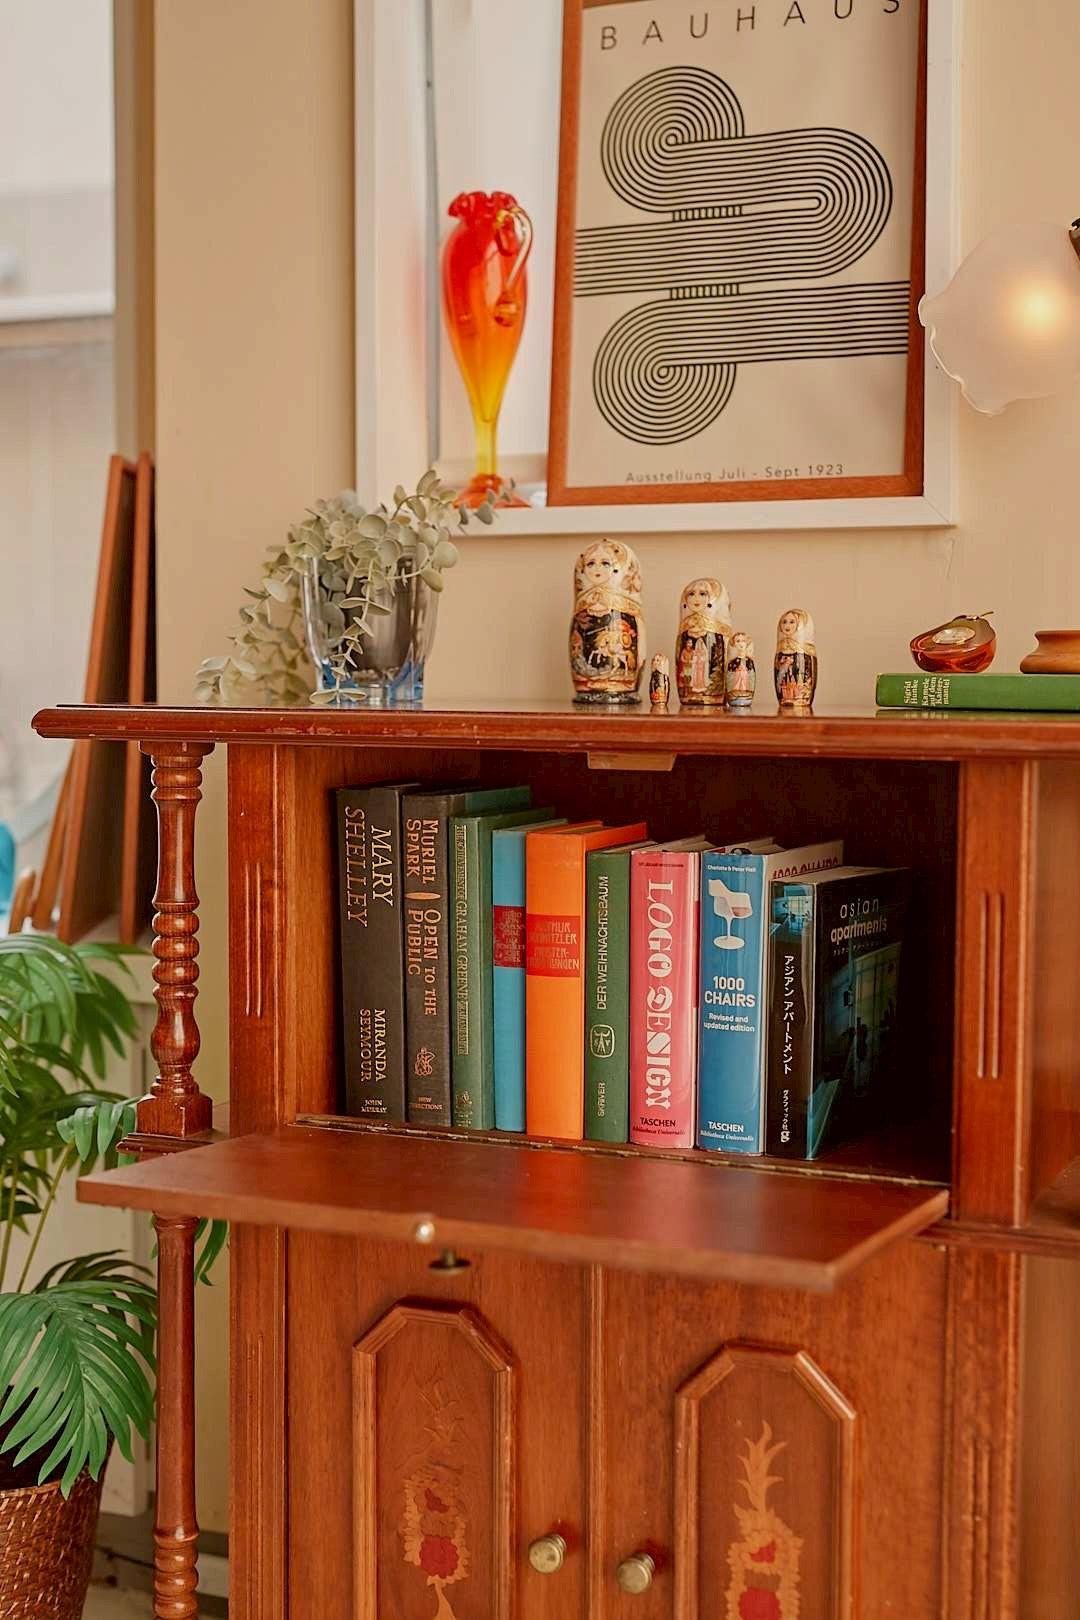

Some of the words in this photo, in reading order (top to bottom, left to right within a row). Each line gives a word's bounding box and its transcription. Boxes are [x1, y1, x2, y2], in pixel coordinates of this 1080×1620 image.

[601, 0, 900, 50] BAUHAUS
[625, 469, 712, 483] Ausstellung
[719, 467, 746, 480] Juli
[765, 466, 800, 480] Sept
[808, 464, 844, 476] 1923
[904, 681, 912, 704] Sigrid
[911, 679, 919, 704] Hunke
[922, 678, 930, 706] Kamele
[929, 677, 937, 693] dem
[406, 818, 421, 877] SPARK
[422, 819, 438, 884] MURIEL
[345, 806, 368, 928] SHELLEY
[371, 825, 394, 907] MARY
[840, 898, 879, 919] asian
[407, 909, 423, 976] PUBLIC
[423, 909, 442, 961] OPEN
[456, 901, 468, 952] GRAHAM
[597, 876, 608, 983] WEIHNACHTSBAUM
[647, 879, 674, 978] LOGO
[831, 917, 887, 945] apartments
[424, 967, 436, 983] TO
[457, 955, 468, 1000] GREENE
[713, 976, 745, 991] 1000
[783, 955, 795, 997] アジアン
[424, 988, 437, 1016] THE
[597, 986, 607, 1009] DER
[704, 990, 756, 1007] CHAIRS
[703, 1021, 730, 1030] updated
[730, 1024, 755, 1032] edition
[708, 1012, 734, 1022] Revised
[359, 1008, 373, 1082] SEYMOUR
[374, 1008, 388, 1082] MIRANDA
[646, 986, 674, 1110] DESIGN
[783, 1001, 795, 1075] アパートメント
[640, 1117, 676, 1127] TASCHEN
[708, 1121, 744, 1132] TASCHEN
